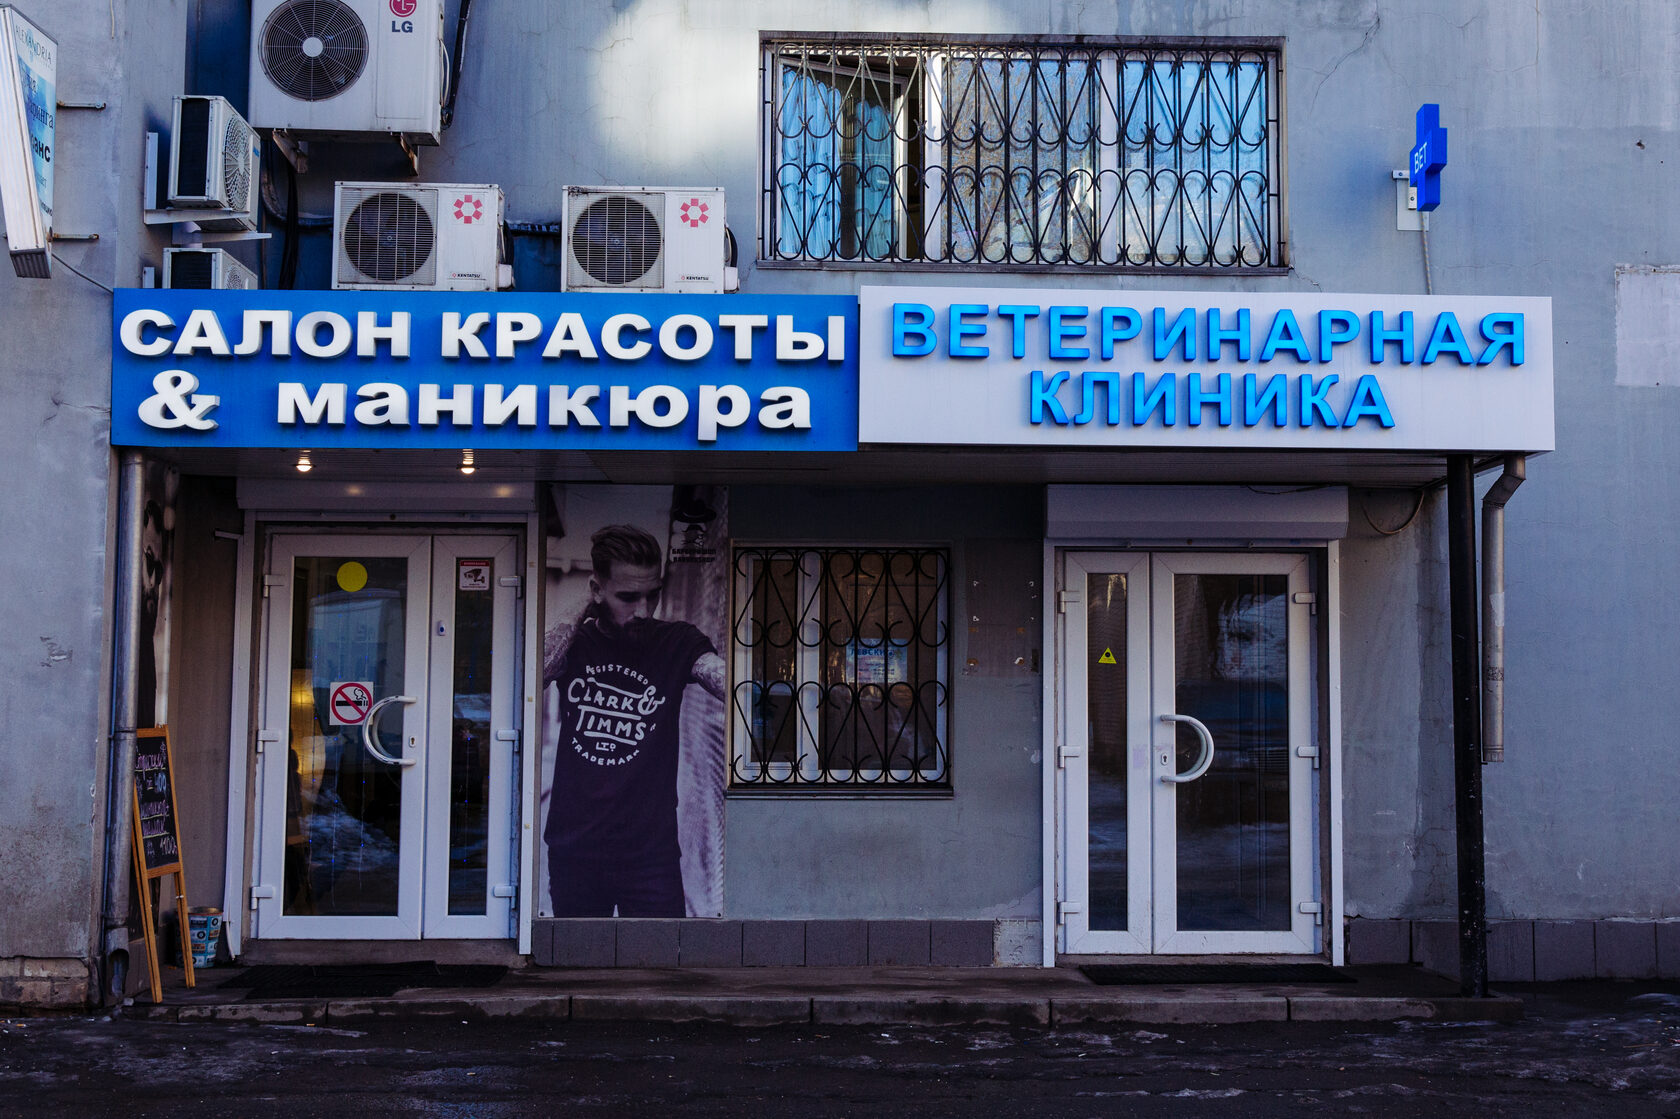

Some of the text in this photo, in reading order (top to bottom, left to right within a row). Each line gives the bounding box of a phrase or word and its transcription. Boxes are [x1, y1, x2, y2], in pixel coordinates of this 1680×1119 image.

[392, 20, 413, 33] LG
[1414, 142, 1428, 174] ВЕТ
[120, 309, 846, 363] САЛОН КРАСОТЫ
[892, 302, 1525, 366] ВЕТЕРИНАРНАЯ
[138, 369, 813, 441] & маникюра
[1029, 370, 1395, 428] КЛИНИКА
[568, 678, 634, 711] CLARK
[586, 663, 649, 685] REGISTERED
